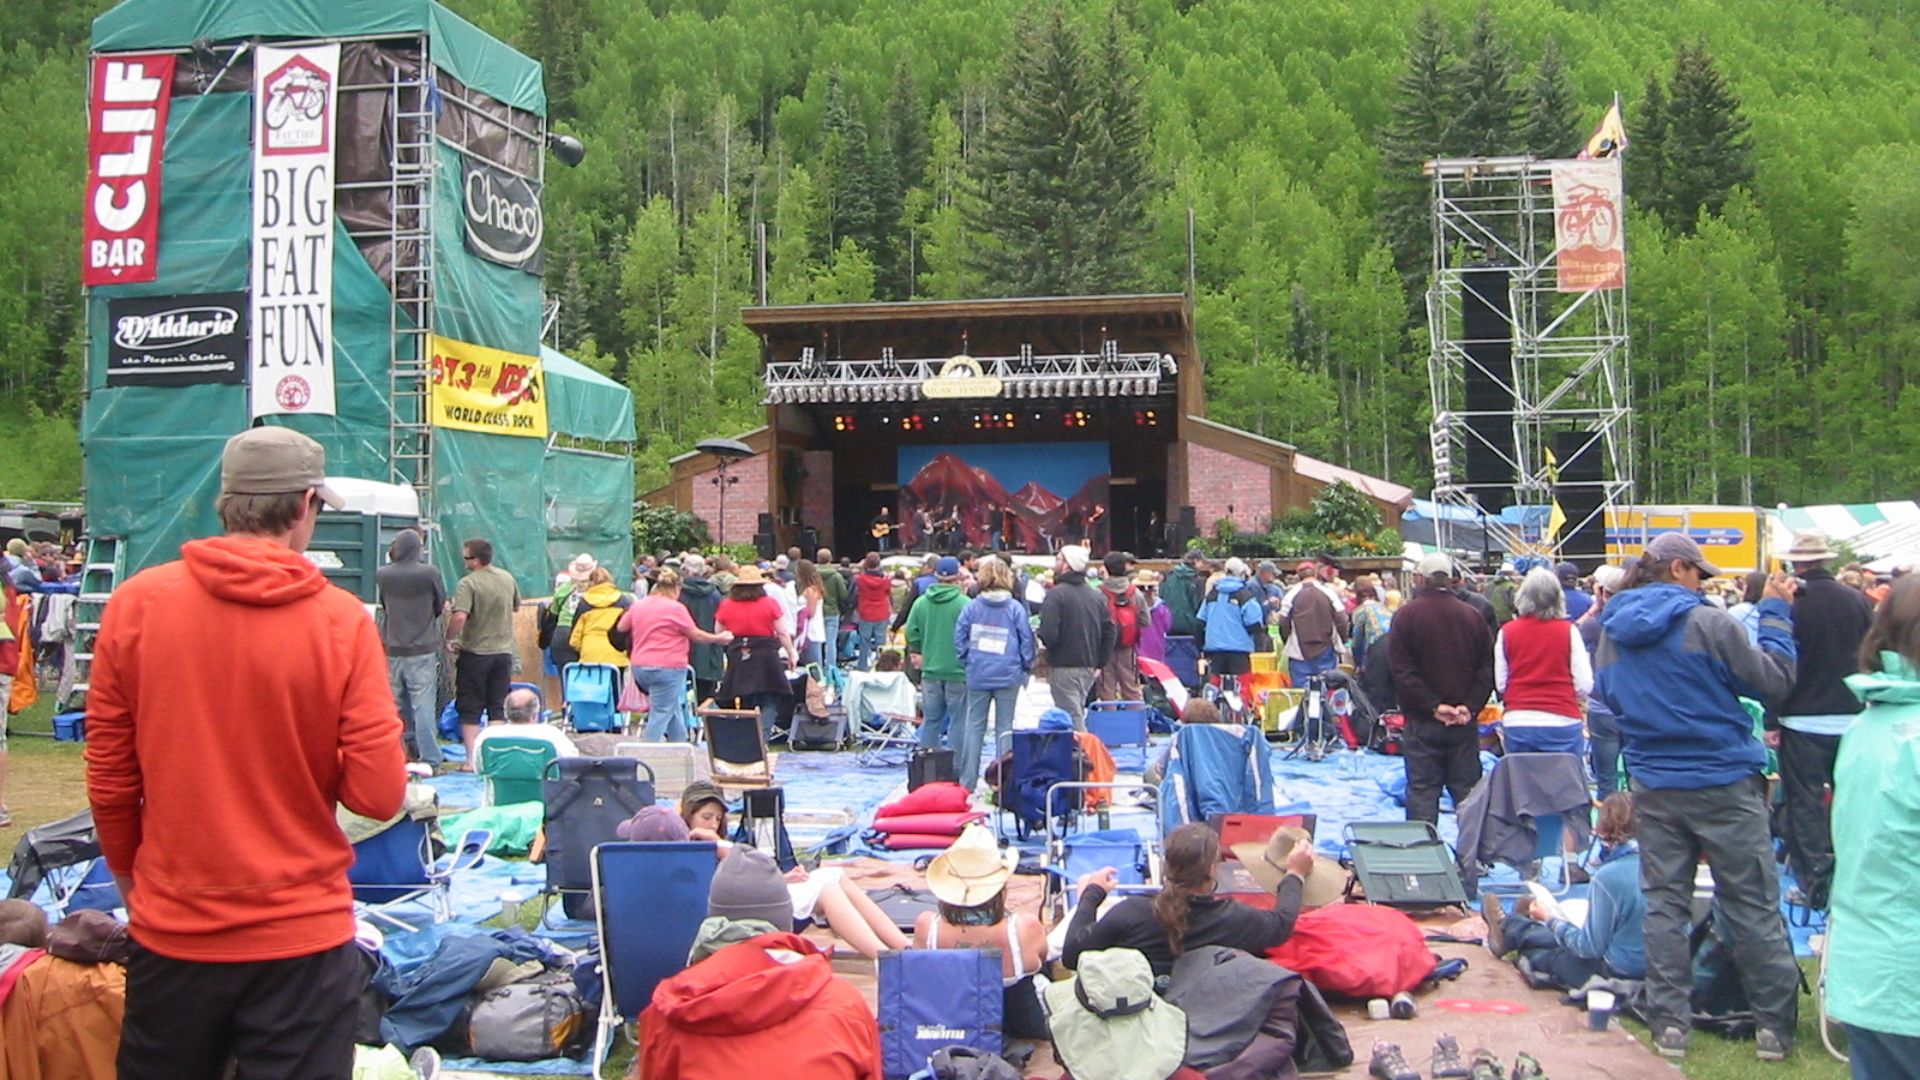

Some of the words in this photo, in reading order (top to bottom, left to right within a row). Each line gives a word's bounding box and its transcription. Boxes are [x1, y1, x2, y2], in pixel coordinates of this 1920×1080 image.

[95, 61, 162, 232] CLIF
[261, 165, 327, 228] BIG
[466, 170, 537, 238] Chaco
[91, 238, 145, 268] BAR
[260, 234, 326, 298] FAT
[116, 312, 236, 346] D'Addario
[259, 303, 326, 368] FUN
[444, 404, 481, 424] WORLD
[482, 411, 511, 427] CLASS
[512, 413, 535, 429] ROCK
